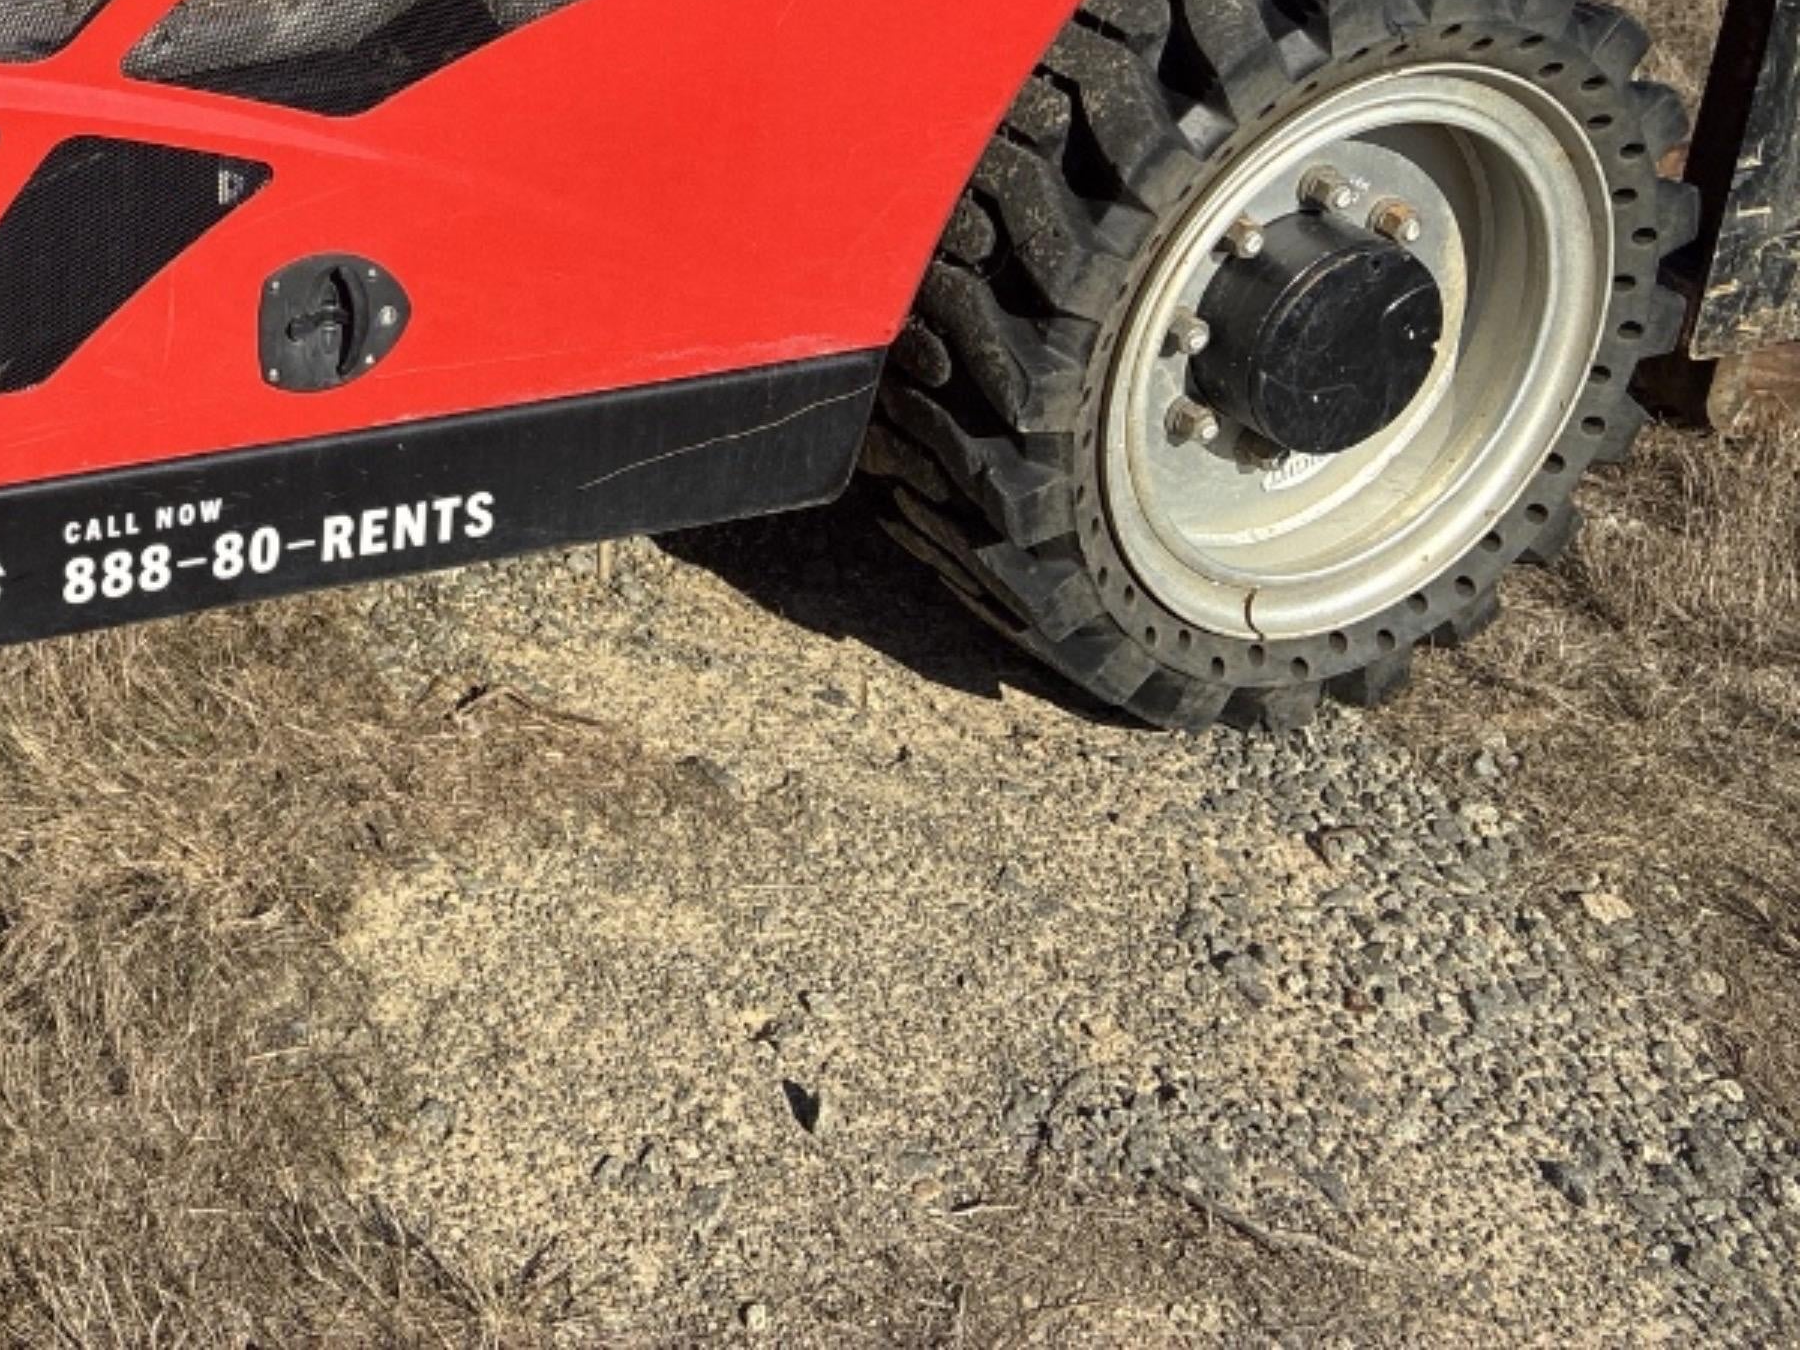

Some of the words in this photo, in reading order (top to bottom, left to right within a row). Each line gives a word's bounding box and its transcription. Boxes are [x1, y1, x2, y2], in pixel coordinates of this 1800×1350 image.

[61, 490, 496, 605] 888-80-RENTS
[63, 511, 142, 545] CALL
[155, 497, 224, 531] NOW
